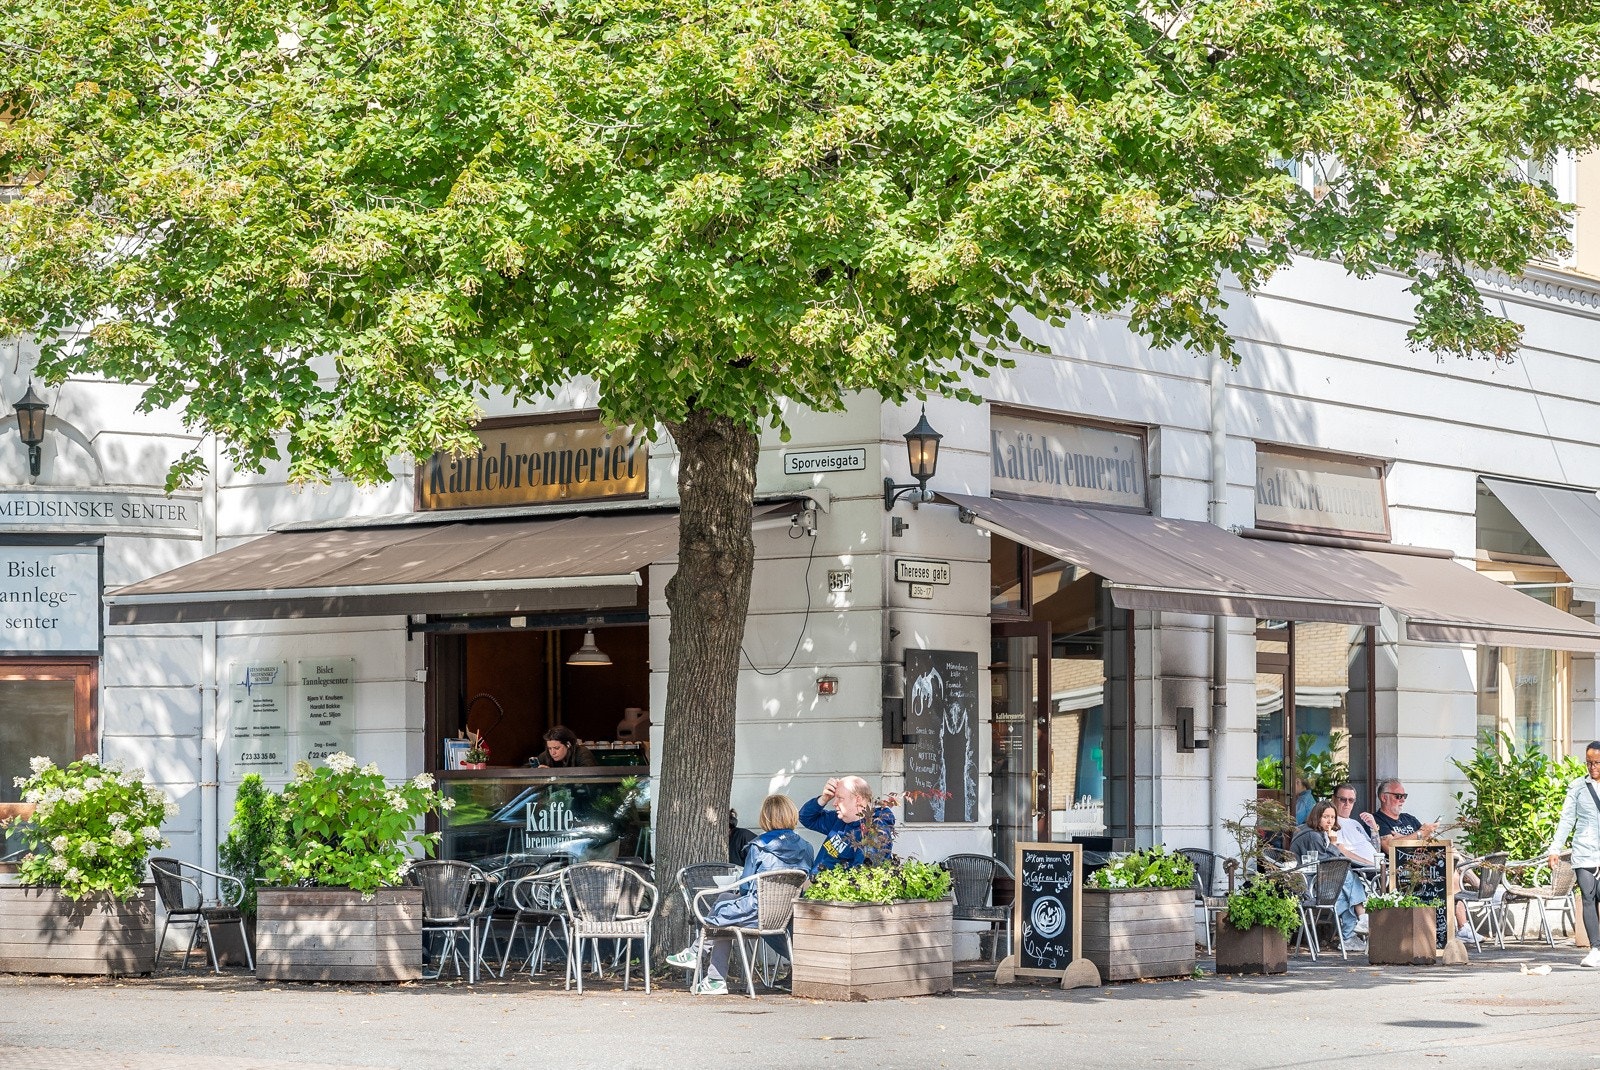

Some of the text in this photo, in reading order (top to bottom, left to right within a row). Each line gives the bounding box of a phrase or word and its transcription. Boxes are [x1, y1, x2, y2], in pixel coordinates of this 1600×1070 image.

[430, 436, 639, 495] Kaffebrenneriet
[791, 455, 859, 471] Sporveisgata
[991, 430, 1140, 495] Kaffebrenneriet
[0, 500, 188, 521] MEDISINSKE SENTER
[7, 561, 57, 578] Bislet
[901, 563, 948, 582] Thereses gate
[5, 617, 59, 629] senter
[316, 666, 334, 674] Bislet
[302, 677, 349, 687] Tannlegesenter
[525, 802, 574, 832] Kaffe
